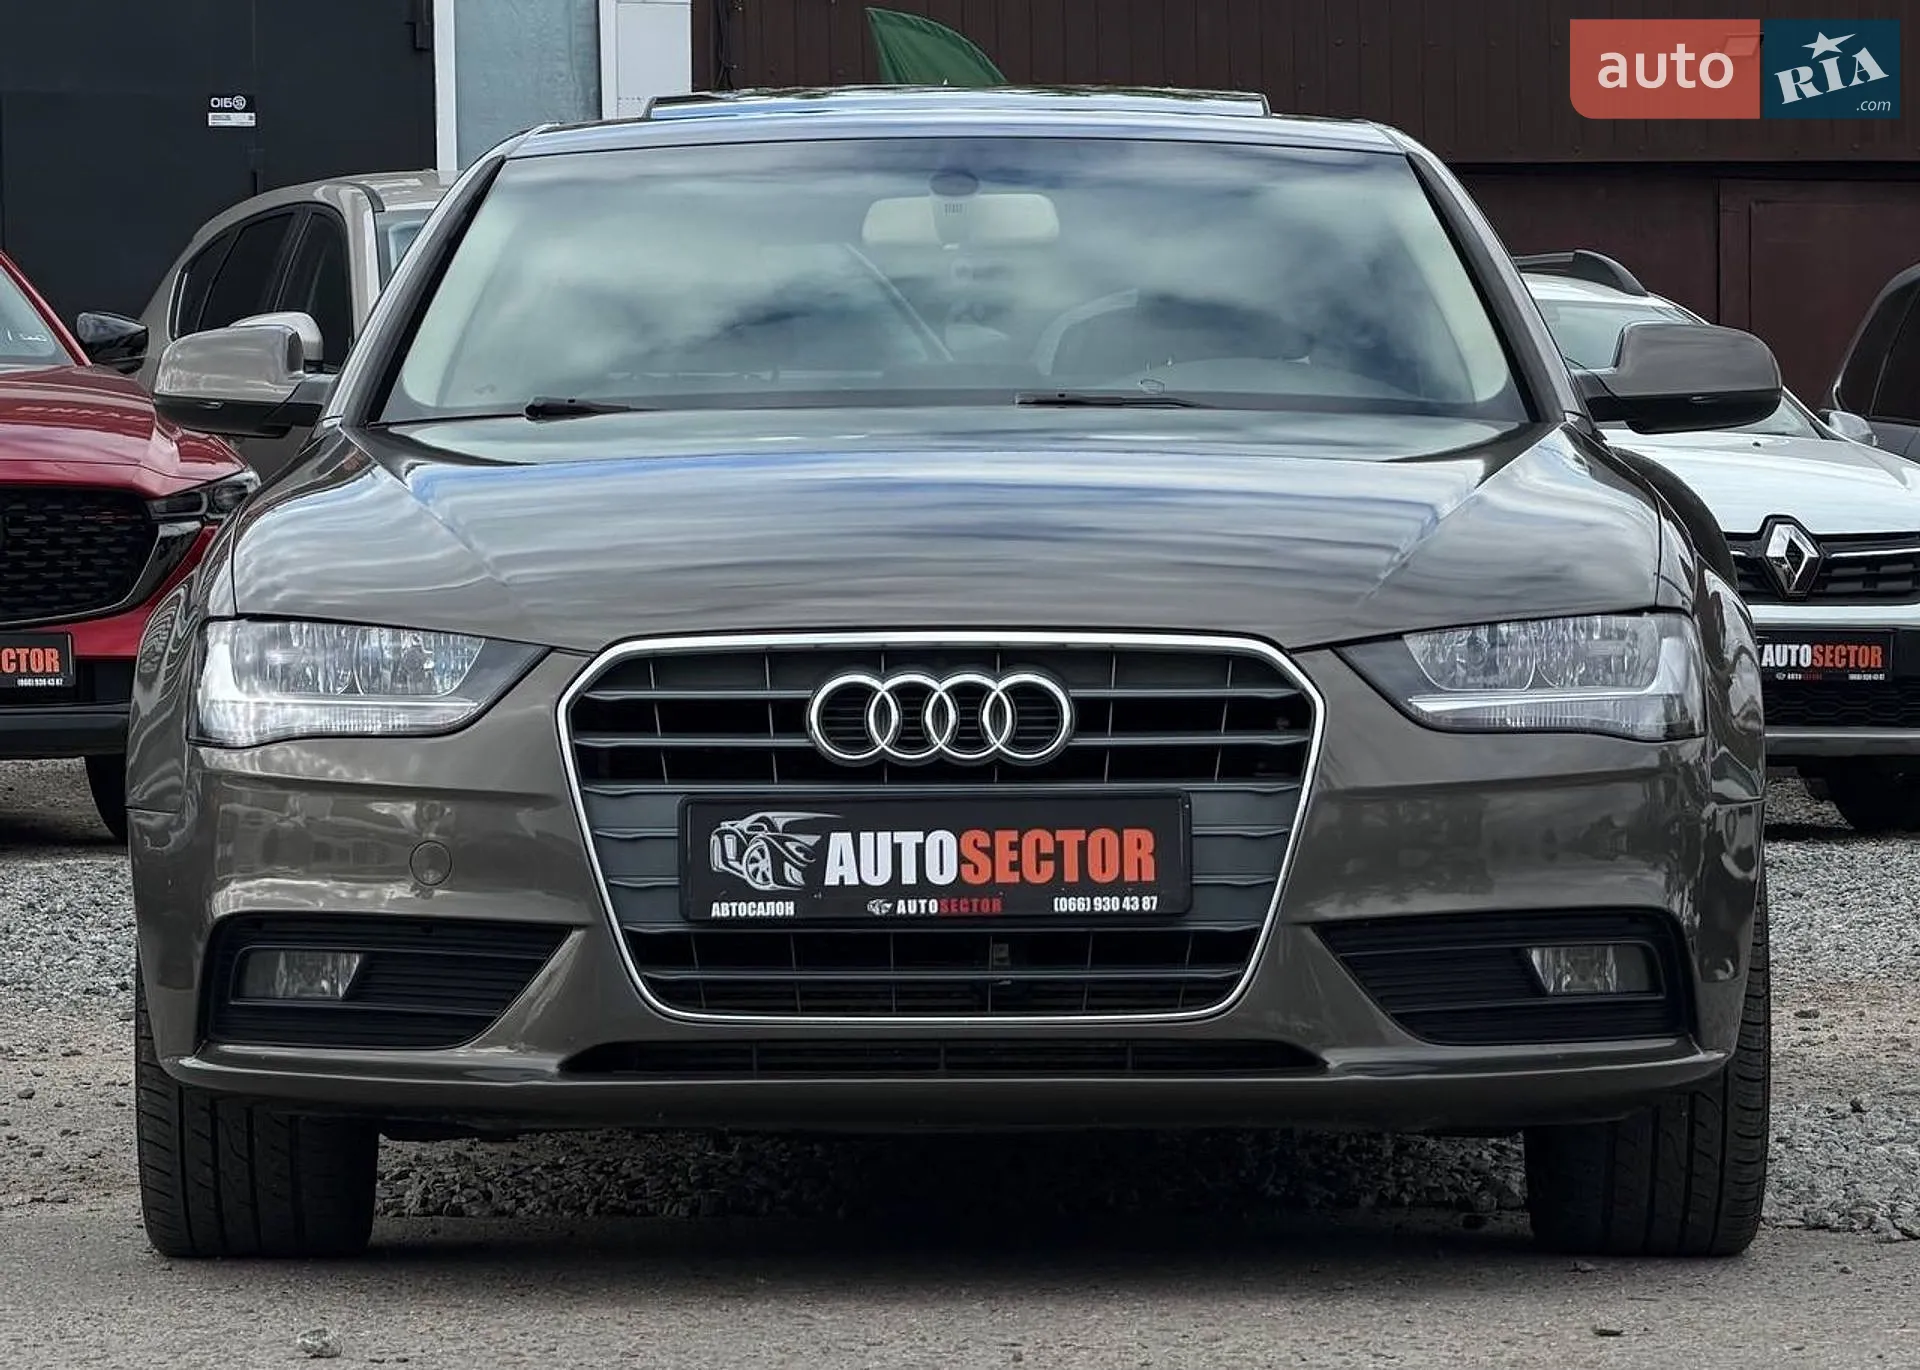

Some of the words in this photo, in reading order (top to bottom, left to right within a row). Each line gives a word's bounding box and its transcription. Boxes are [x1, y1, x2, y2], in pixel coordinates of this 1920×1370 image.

[1761, 643, 1882, 668] AUTOSECTOR
[824, 828, 1155, 887] AUTOSECTOR
[711, 901, 795, 917] АВТОСАЛОН
[896, 898, 1003, 915] AUTOSECTOR
[1053, 896, 1091, 912] (066)
[1093, 896, 1120, 911] 930
[1122, 896, 1140, 911] 43
[1141, 896, 1158, 911] 87
